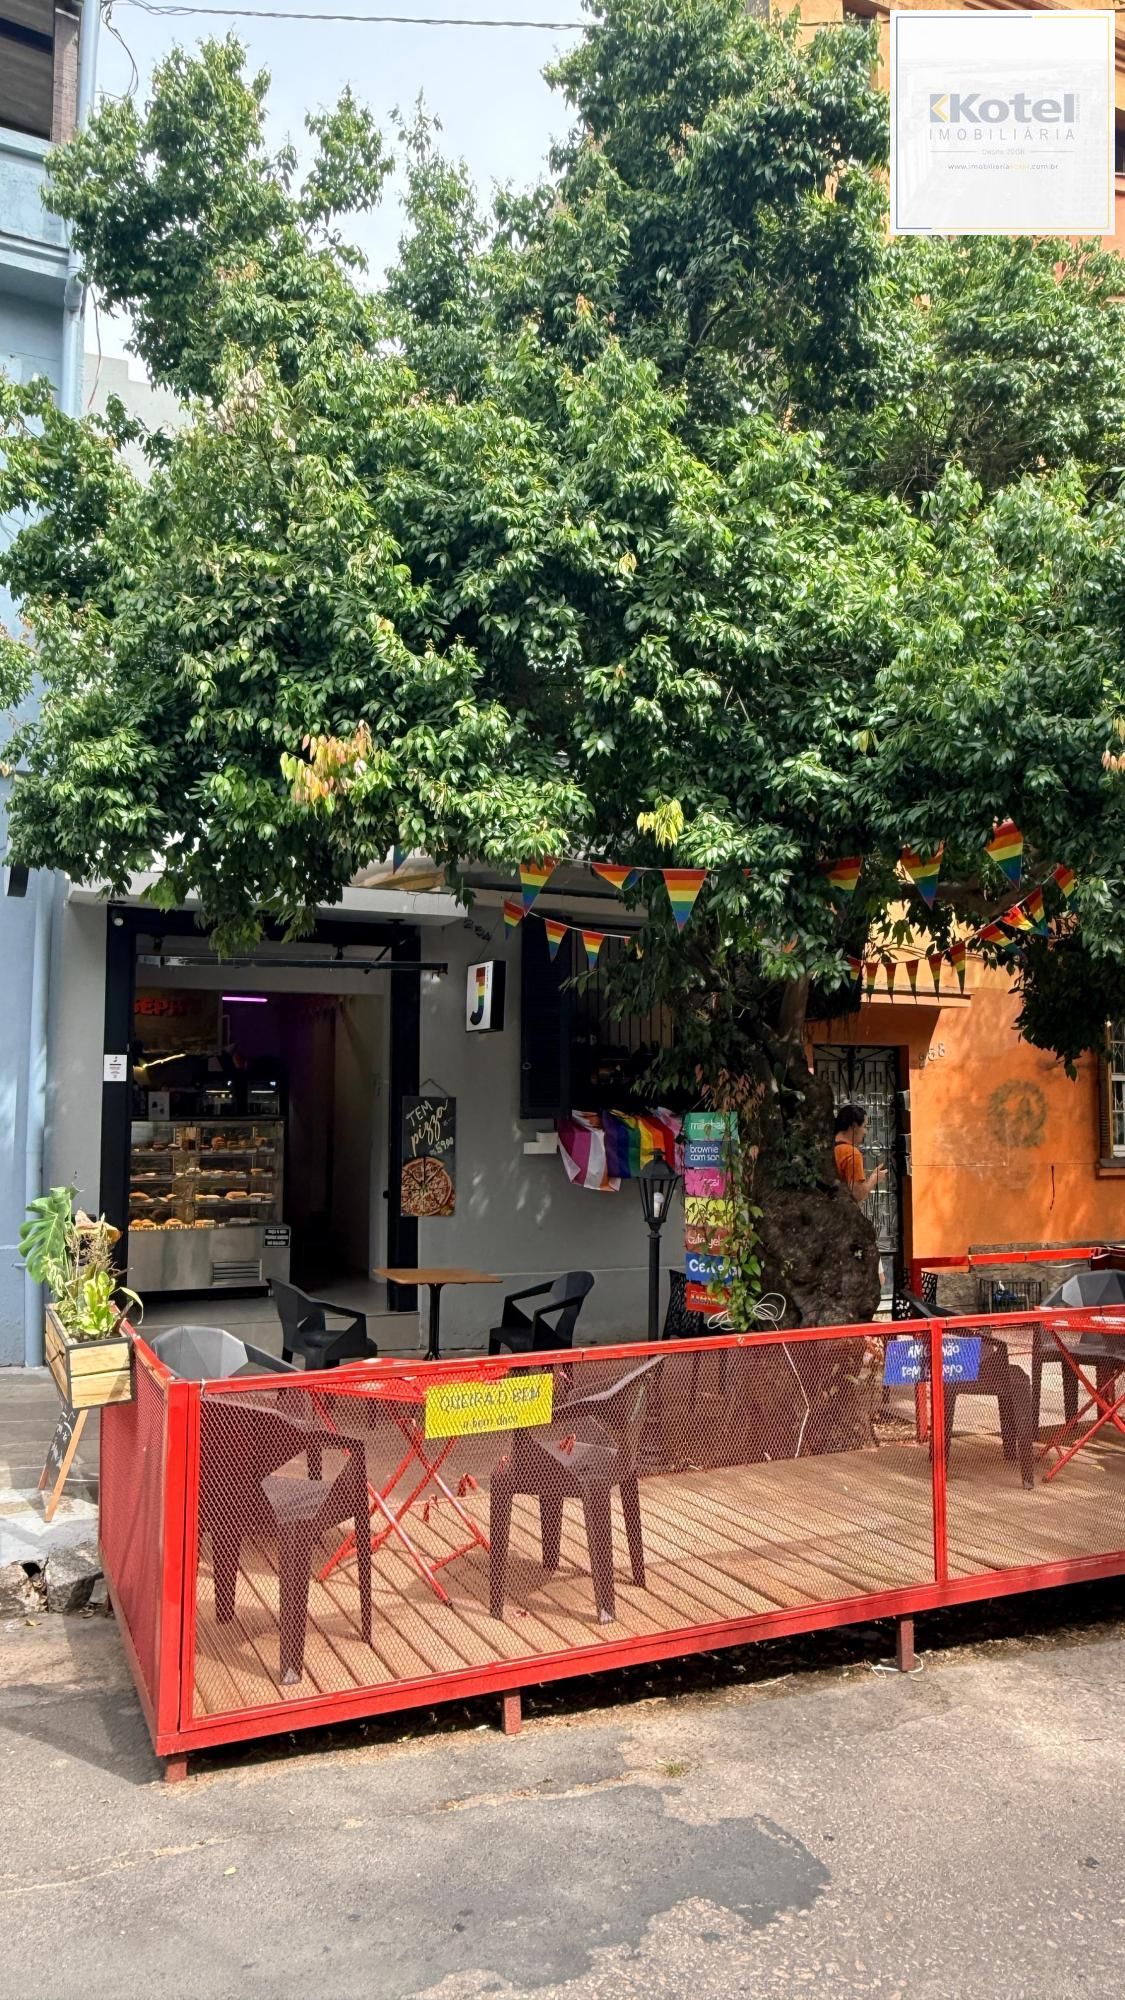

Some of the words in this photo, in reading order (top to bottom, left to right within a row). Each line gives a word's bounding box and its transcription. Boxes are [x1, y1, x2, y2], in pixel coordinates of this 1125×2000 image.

[470, 966, 486, 1025] J
[405, 1100, 433, 1127] TEM
[411, 1099, 449, 1157] pizza
[689, 1144, 719, 1153] brownie
